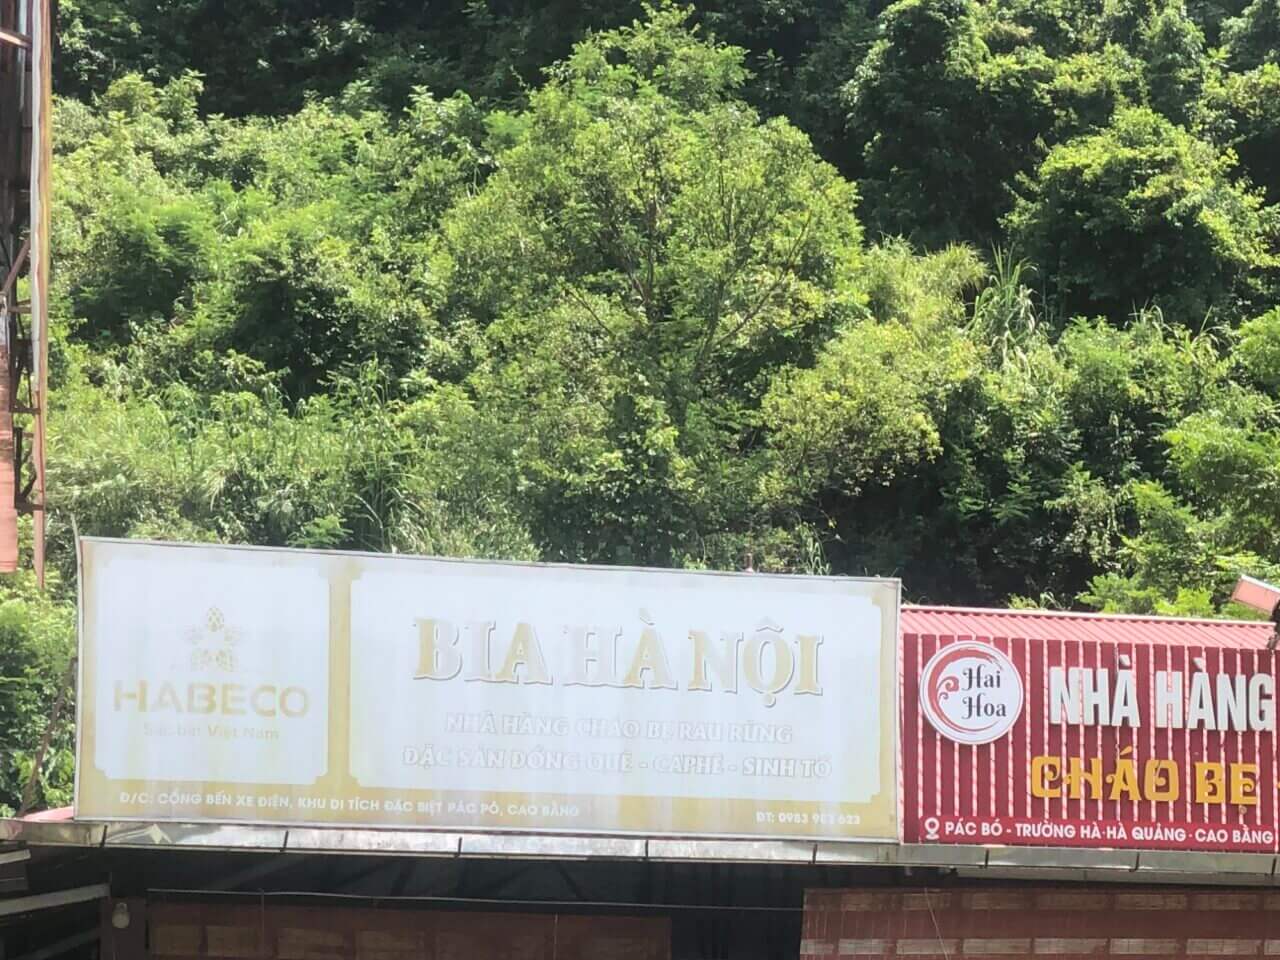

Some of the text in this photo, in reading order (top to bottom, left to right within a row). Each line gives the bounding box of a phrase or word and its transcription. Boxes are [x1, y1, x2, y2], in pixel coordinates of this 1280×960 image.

[413, 606, 824, 708] BIA HÀ NỘI
[112, 679, 311, 718] HABECO
[961, 693, 1007, 719] Hoa
[1050, 654, 1141, 728] NHÀ
[1155, 657, 1275, 732] HÀNG
[742, 756, 796, 778] SINH
[1031, 746, 1179, 802] CHÁO
[235, 795, 255, 806] XE
[298, 796, 326, 809] KHU
[507, 804, 538, 816] CAO
[945, 819, 977, 836] PÁC
[981, 819, 1002, 837] BÓ
[1015, 820, 1076, 838] TRƯỜNG
[1131, 823, 1186, 842] QUẢNG
[1195, 829, 1228, 843] CAO
